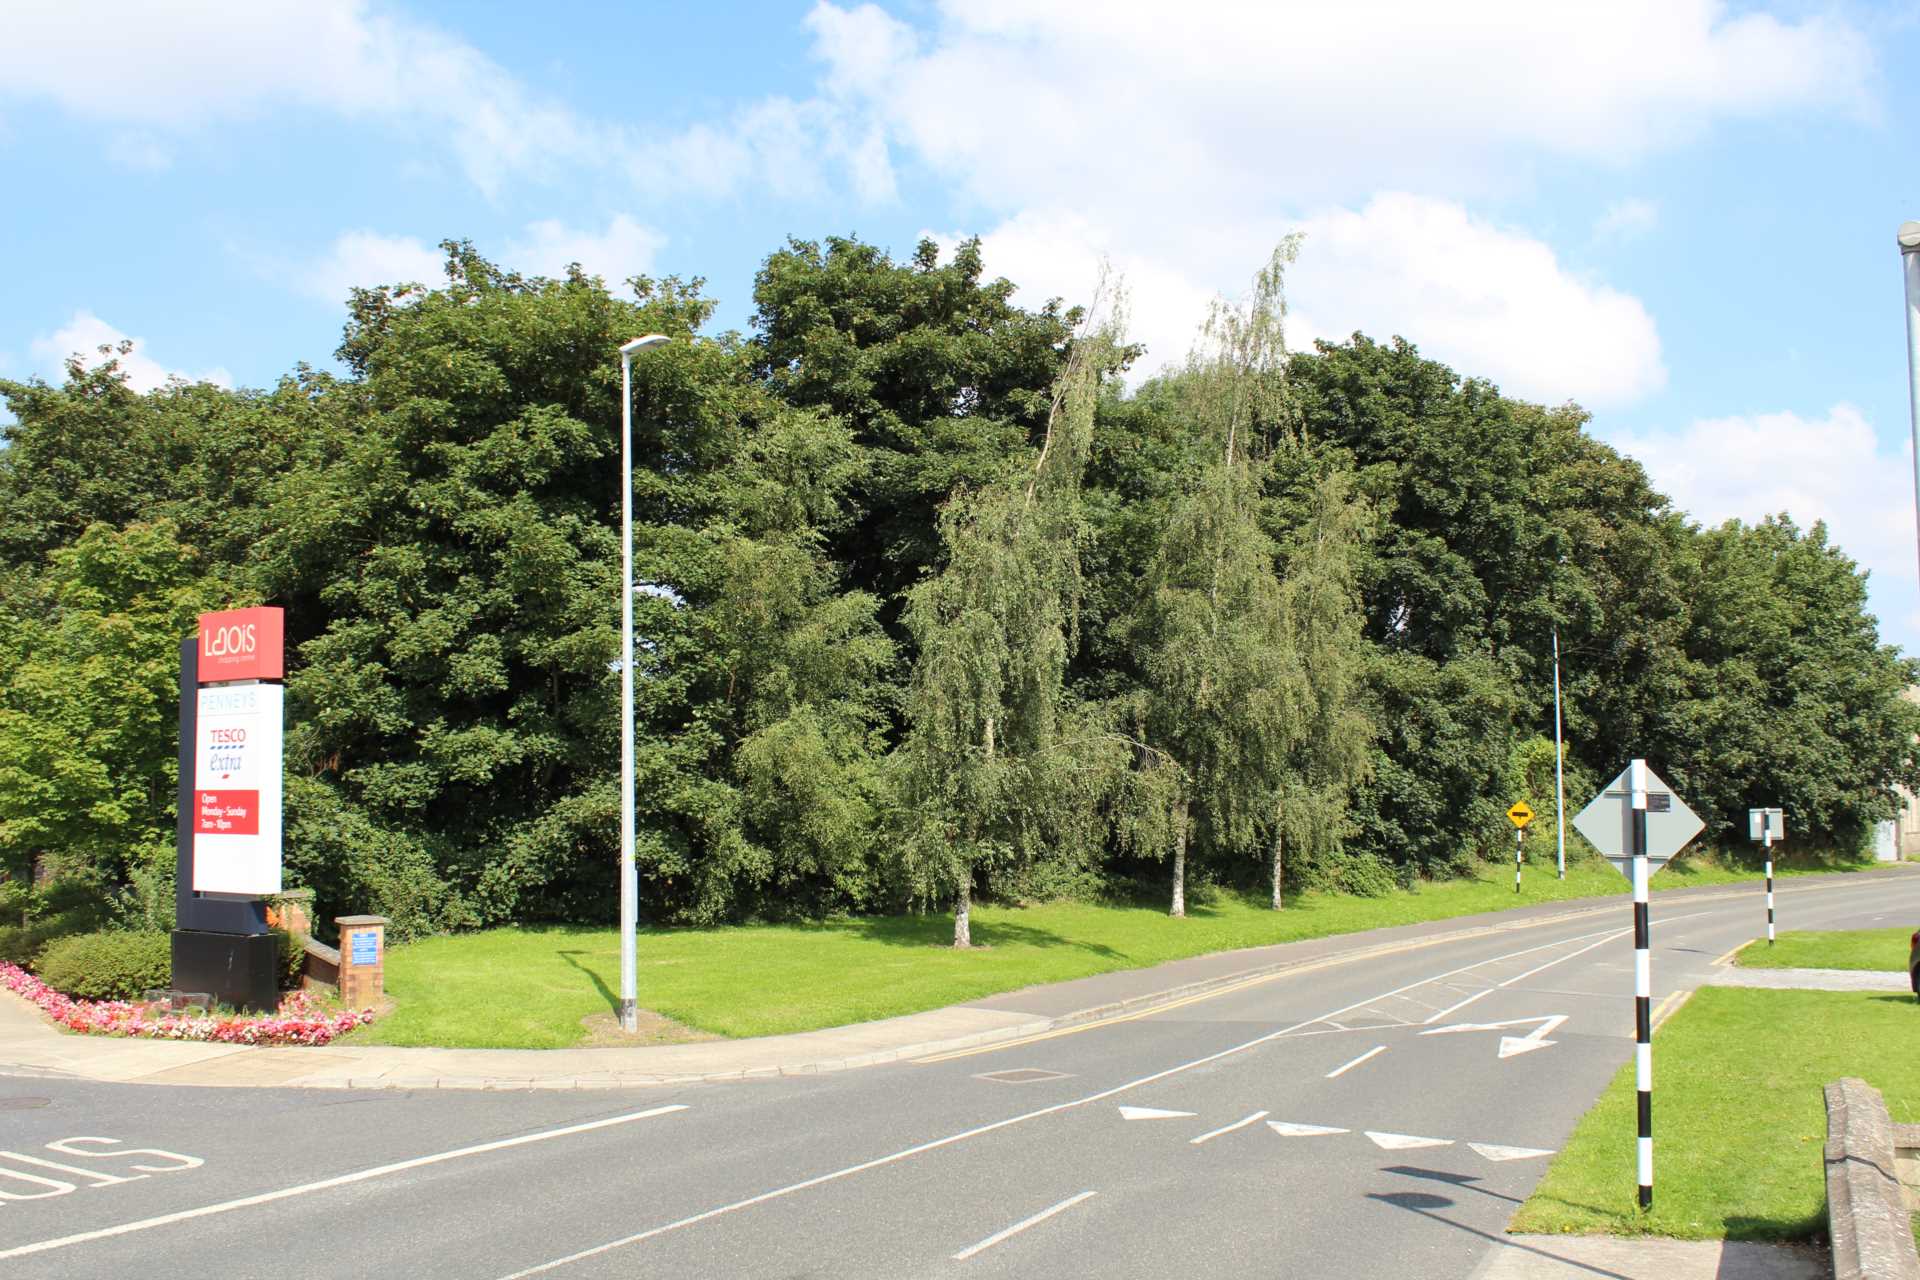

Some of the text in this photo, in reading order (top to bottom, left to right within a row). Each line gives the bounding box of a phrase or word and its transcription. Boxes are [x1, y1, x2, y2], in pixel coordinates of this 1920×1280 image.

[210, 728, 246, 743] TESCO
[210, 753, 242, 771] extra
[202, 793, 217, 805] Open
